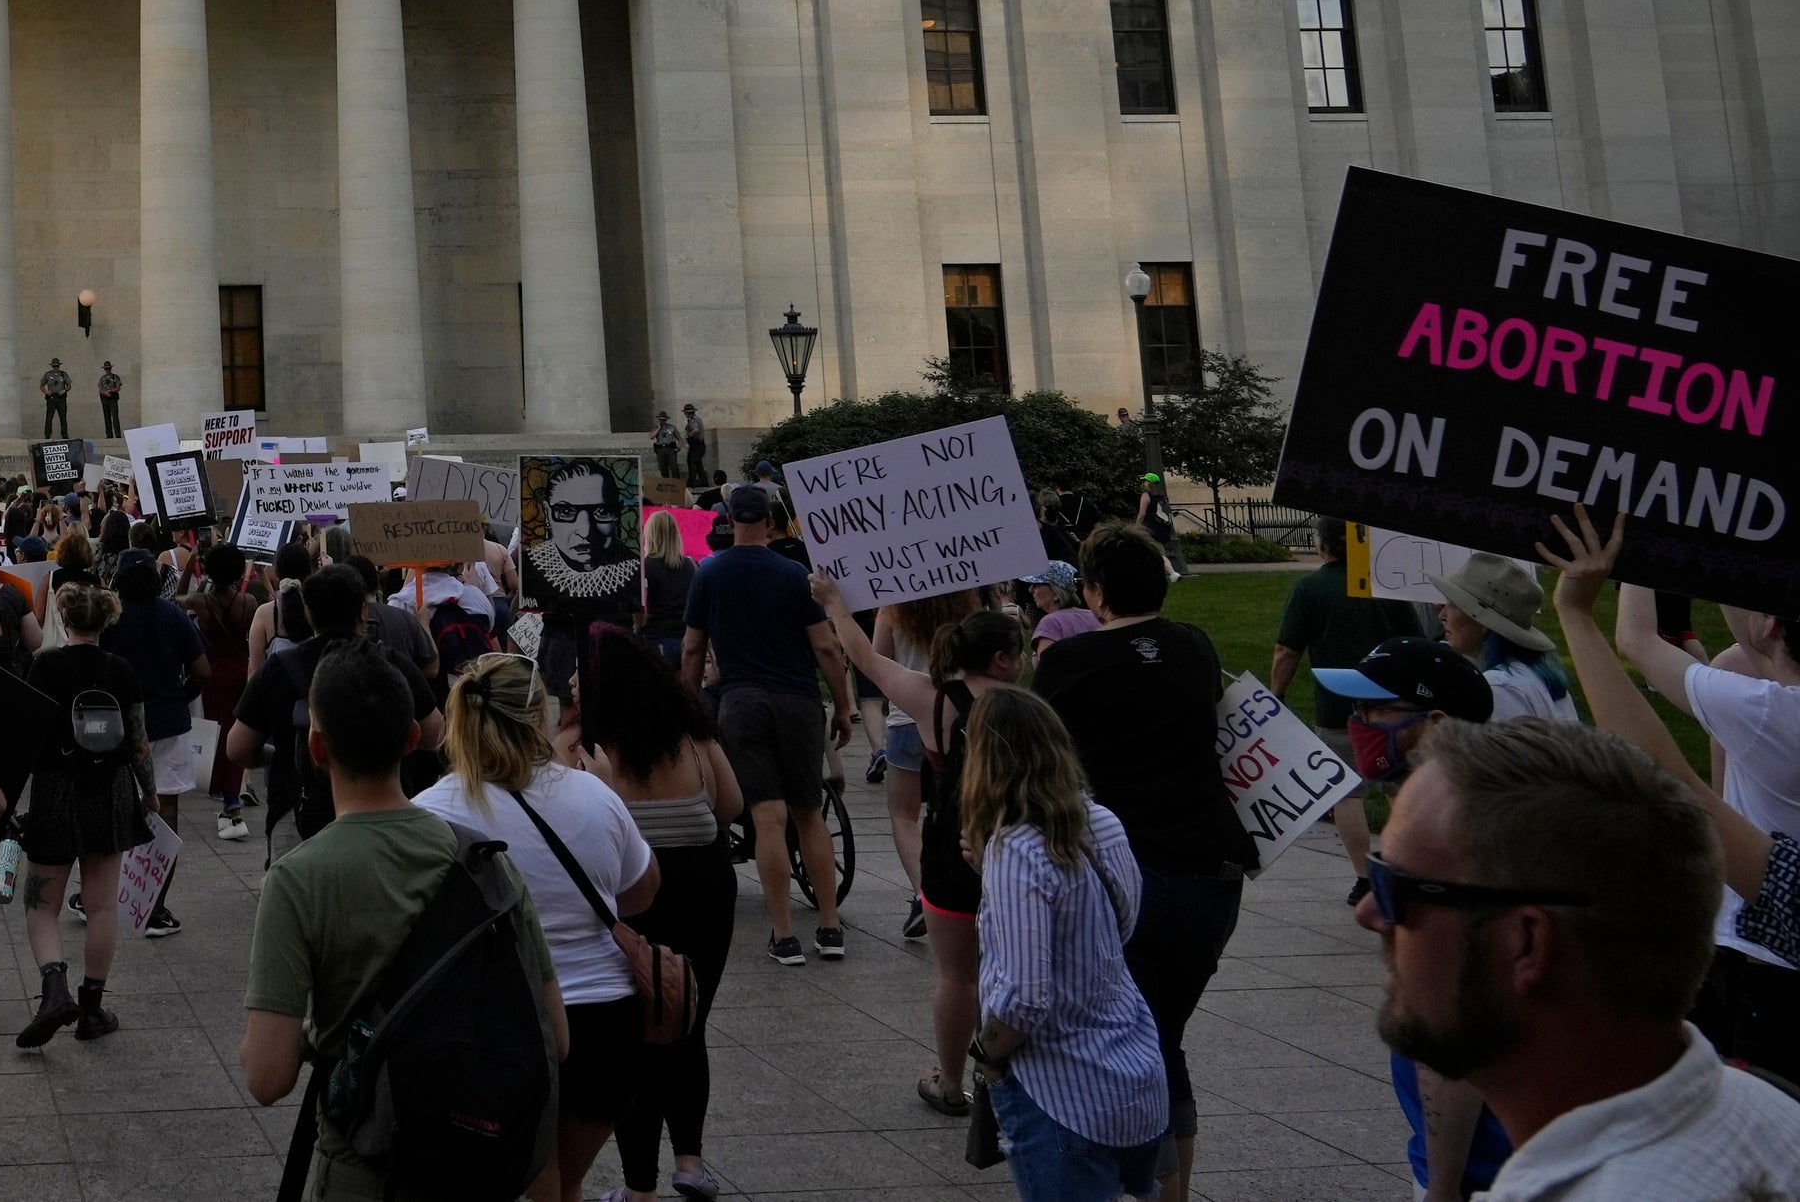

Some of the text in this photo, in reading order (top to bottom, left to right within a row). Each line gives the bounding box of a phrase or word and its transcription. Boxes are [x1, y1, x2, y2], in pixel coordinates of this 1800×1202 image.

[1494, 228, 1708, 333] FREE
[1397, 302, 1775, 437] ABORTION
[205, 415, 239, 431] HERE TO
[205, 427, 254, 449] SUPPORT
[44, 445, 68, 454] STAND
[45, 455, 65, 463] WITH
[46, 463, 70, 471] BLACK
[270, 469, 275, 479] I
[324, 467, 340, 477] the
[797, 432, 976, 495] WE'RE NOT
[48, 471, 77, 480] WOMEN
[1349, 407, 1786, 542] ON DEMAND
[256, 484, 265, 495] in
[443, 463, 518, 524] DISSE
[256, 498, 295, 514] FUCKED
[383, 519, 480, 539] RESTRICTIONS
[817, 527, 1004, 581] WE JUST WANT
[869, 561, 979, 599] RIGHTS!
[84, 720, 108, 735] NIKE
[1222, 737, 1280, 803] NOT
